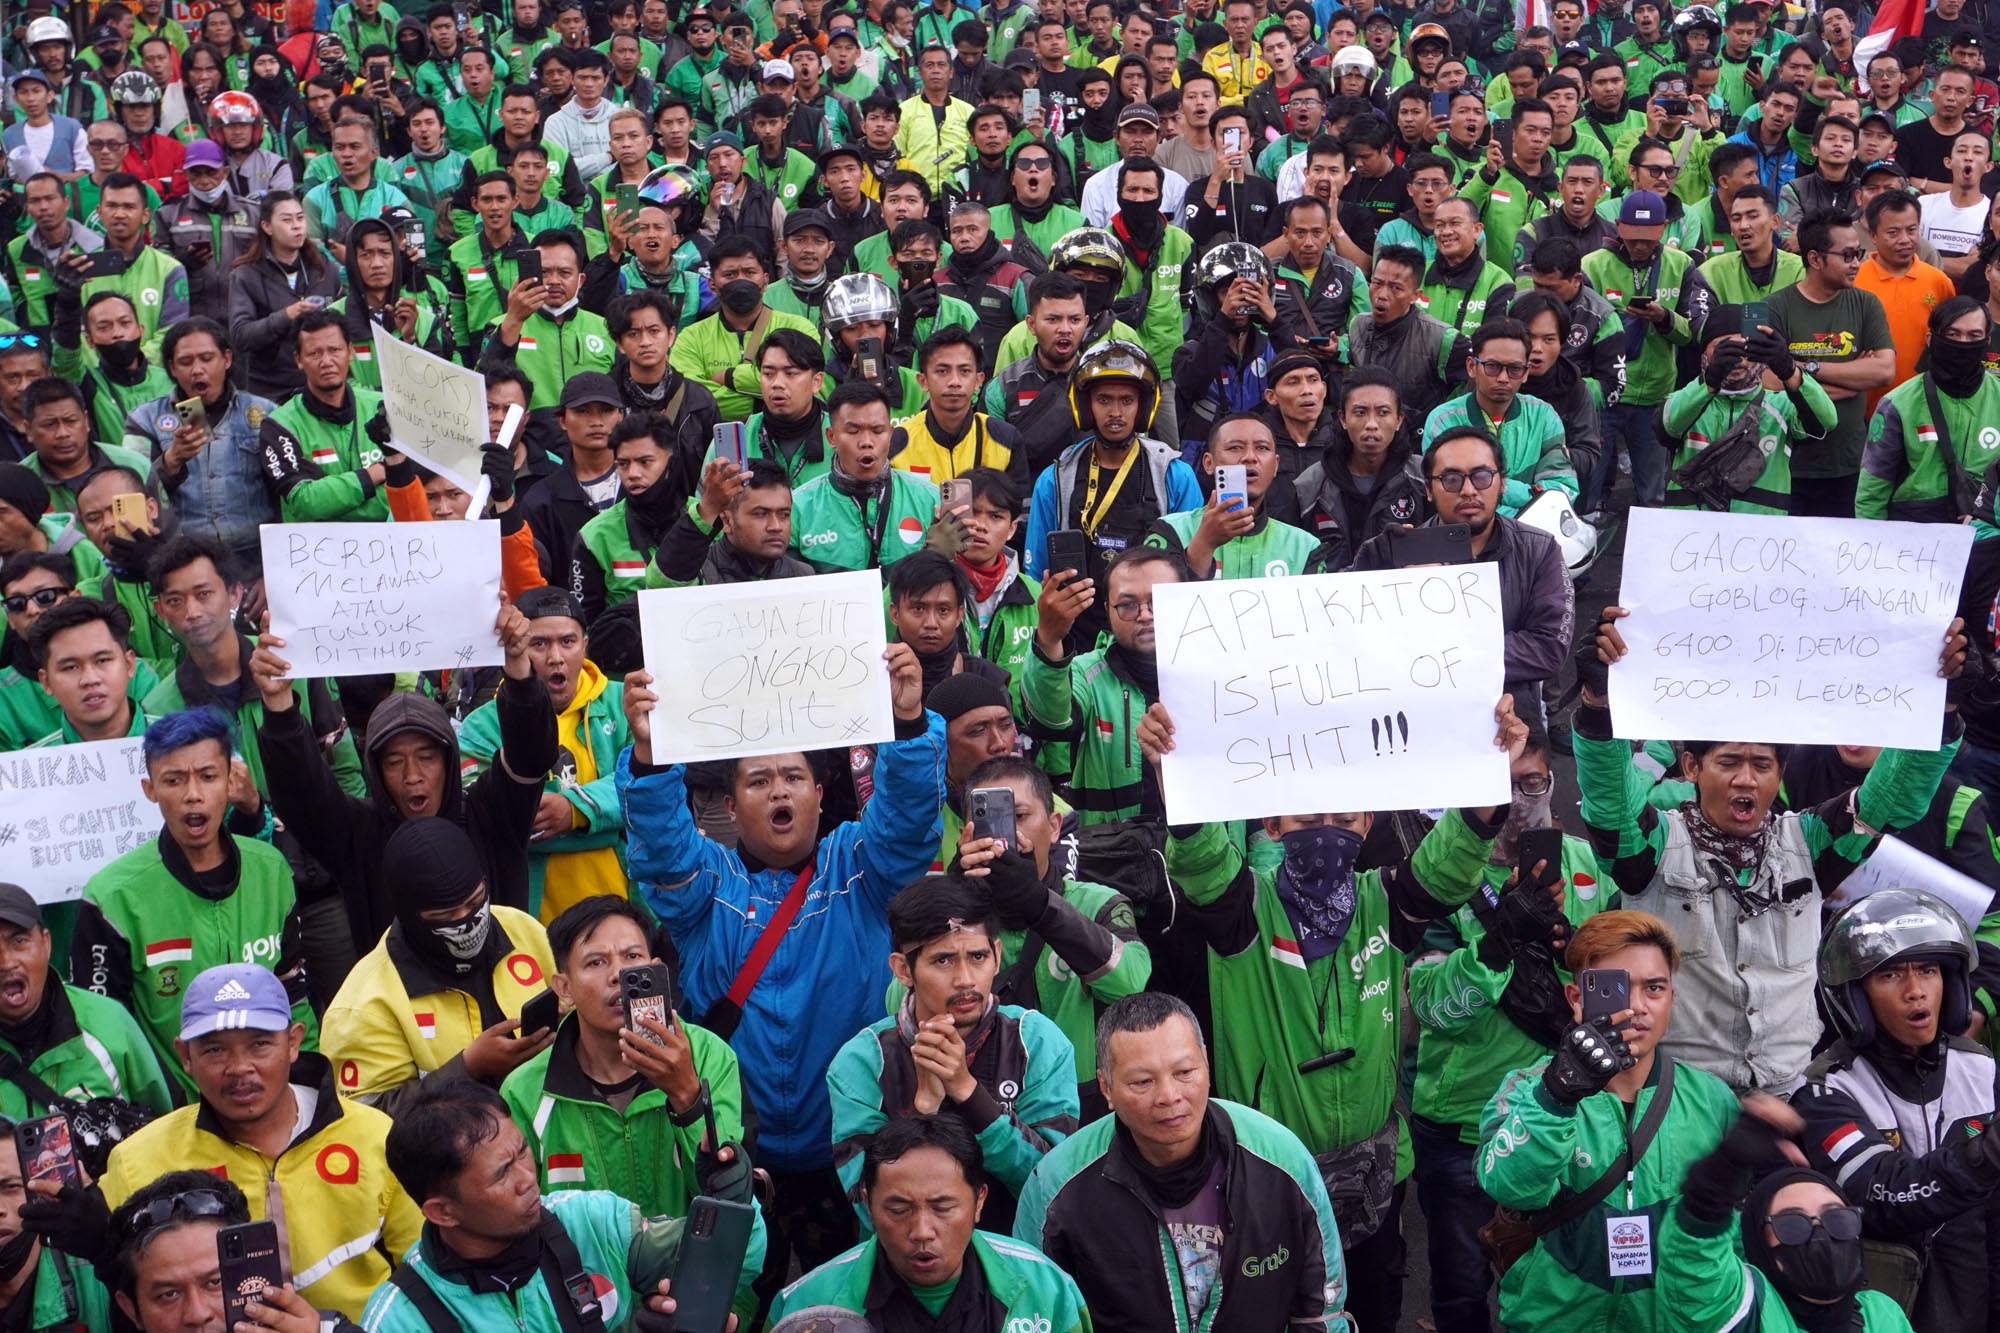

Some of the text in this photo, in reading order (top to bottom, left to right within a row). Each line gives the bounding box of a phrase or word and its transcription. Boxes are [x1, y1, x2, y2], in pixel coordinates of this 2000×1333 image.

[801, 530, 838, 548] Grab
[1835, 539, 1941, 580] BOLEH
[569, 559, 585, 604] tokop
[331, 599, 405, 619] ATAU
[1171, 571, 1497, 665] APLIKATOR
[297, 614, 425, 642] TUNDUK
[701, 641, 870, 700] ONGKOS
[1212, 646, 1463, 724] IS FULL OF
[1226, 710, 1410, 784] SHIT !!!
[0, 751, 107, 791] NAIKAN
[58, 799, 143, 837] CANTIK
[29, 837, 105, 869] BUTUH
[213, 991, 251, 1002] adidas
[630, 994, 664, 1010] WANTED
[246, 1248, 275, 1260] PREMIUM
[1241, 1244, 1290, 1278] Grab
[1610, 1250, 1649, 1262] KEAMANAN
[1617, 1257, 1646, 1269] KORLAP
